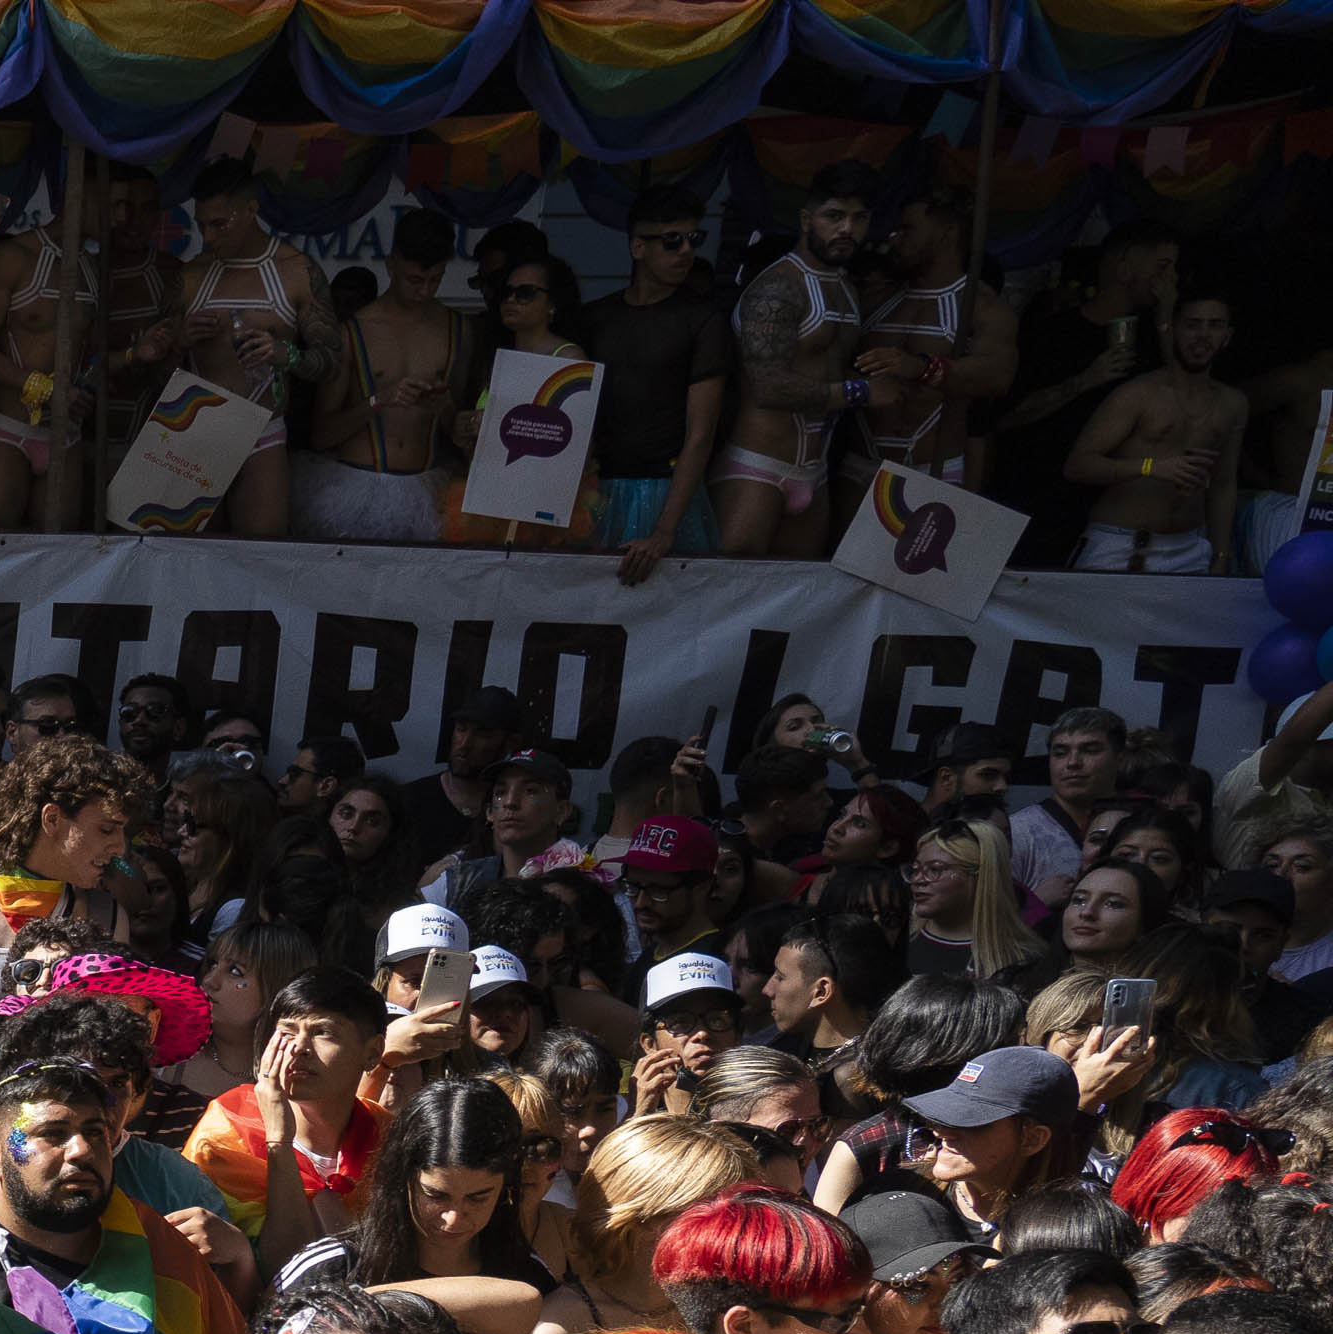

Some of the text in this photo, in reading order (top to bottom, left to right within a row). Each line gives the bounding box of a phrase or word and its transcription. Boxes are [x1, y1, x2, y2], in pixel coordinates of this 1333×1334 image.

[142, 451, 182, 476] discursos
[164, 450, 189, 467] Basta
[1316, 479, 1333, 493] LE
[1308, 506, 1333, 522] INC
[421, 914, 455, 928] igualdad
[481, 951, 514, 963] igualdad
[678, 959, 714, 970] igualdad
